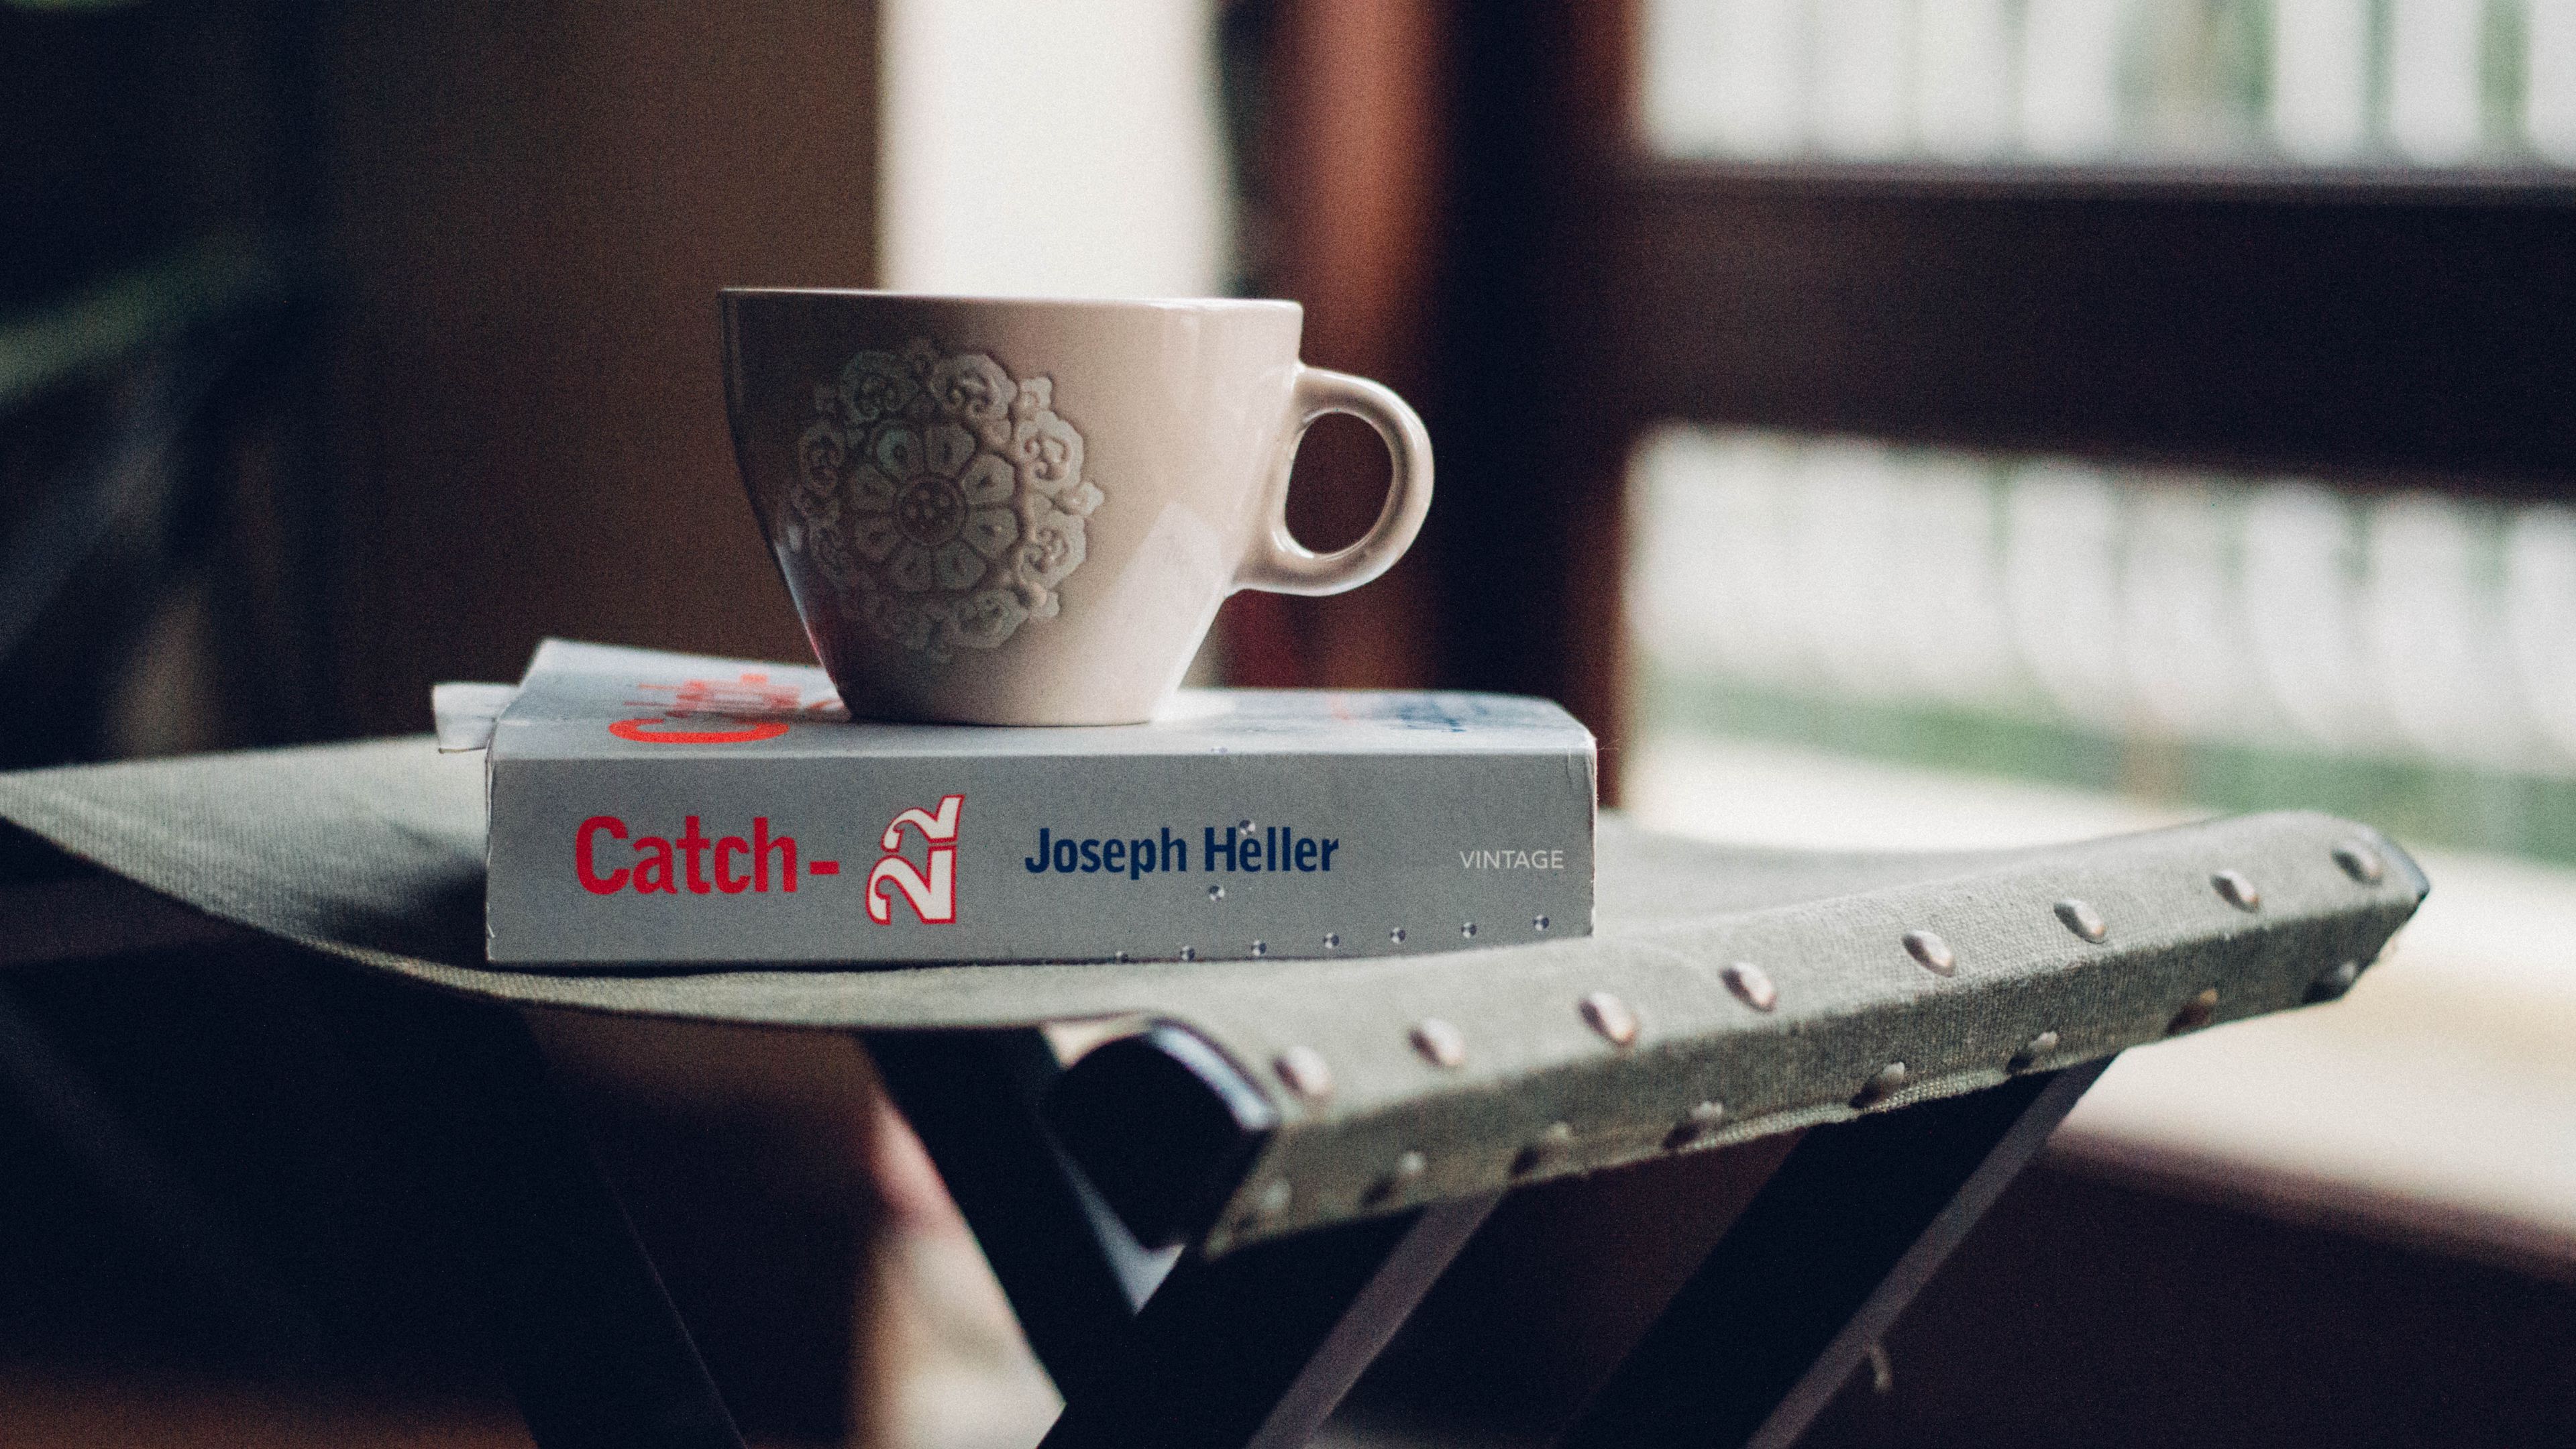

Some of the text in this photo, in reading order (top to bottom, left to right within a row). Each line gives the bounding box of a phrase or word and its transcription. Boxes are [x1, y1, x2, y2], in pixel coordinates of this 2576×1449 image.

[574, 794, 965, 926] Catch- 22
[1024, 827, 1340, 880] Joseph Heller
[1460, 850, 1564, 870] VINTAGE
